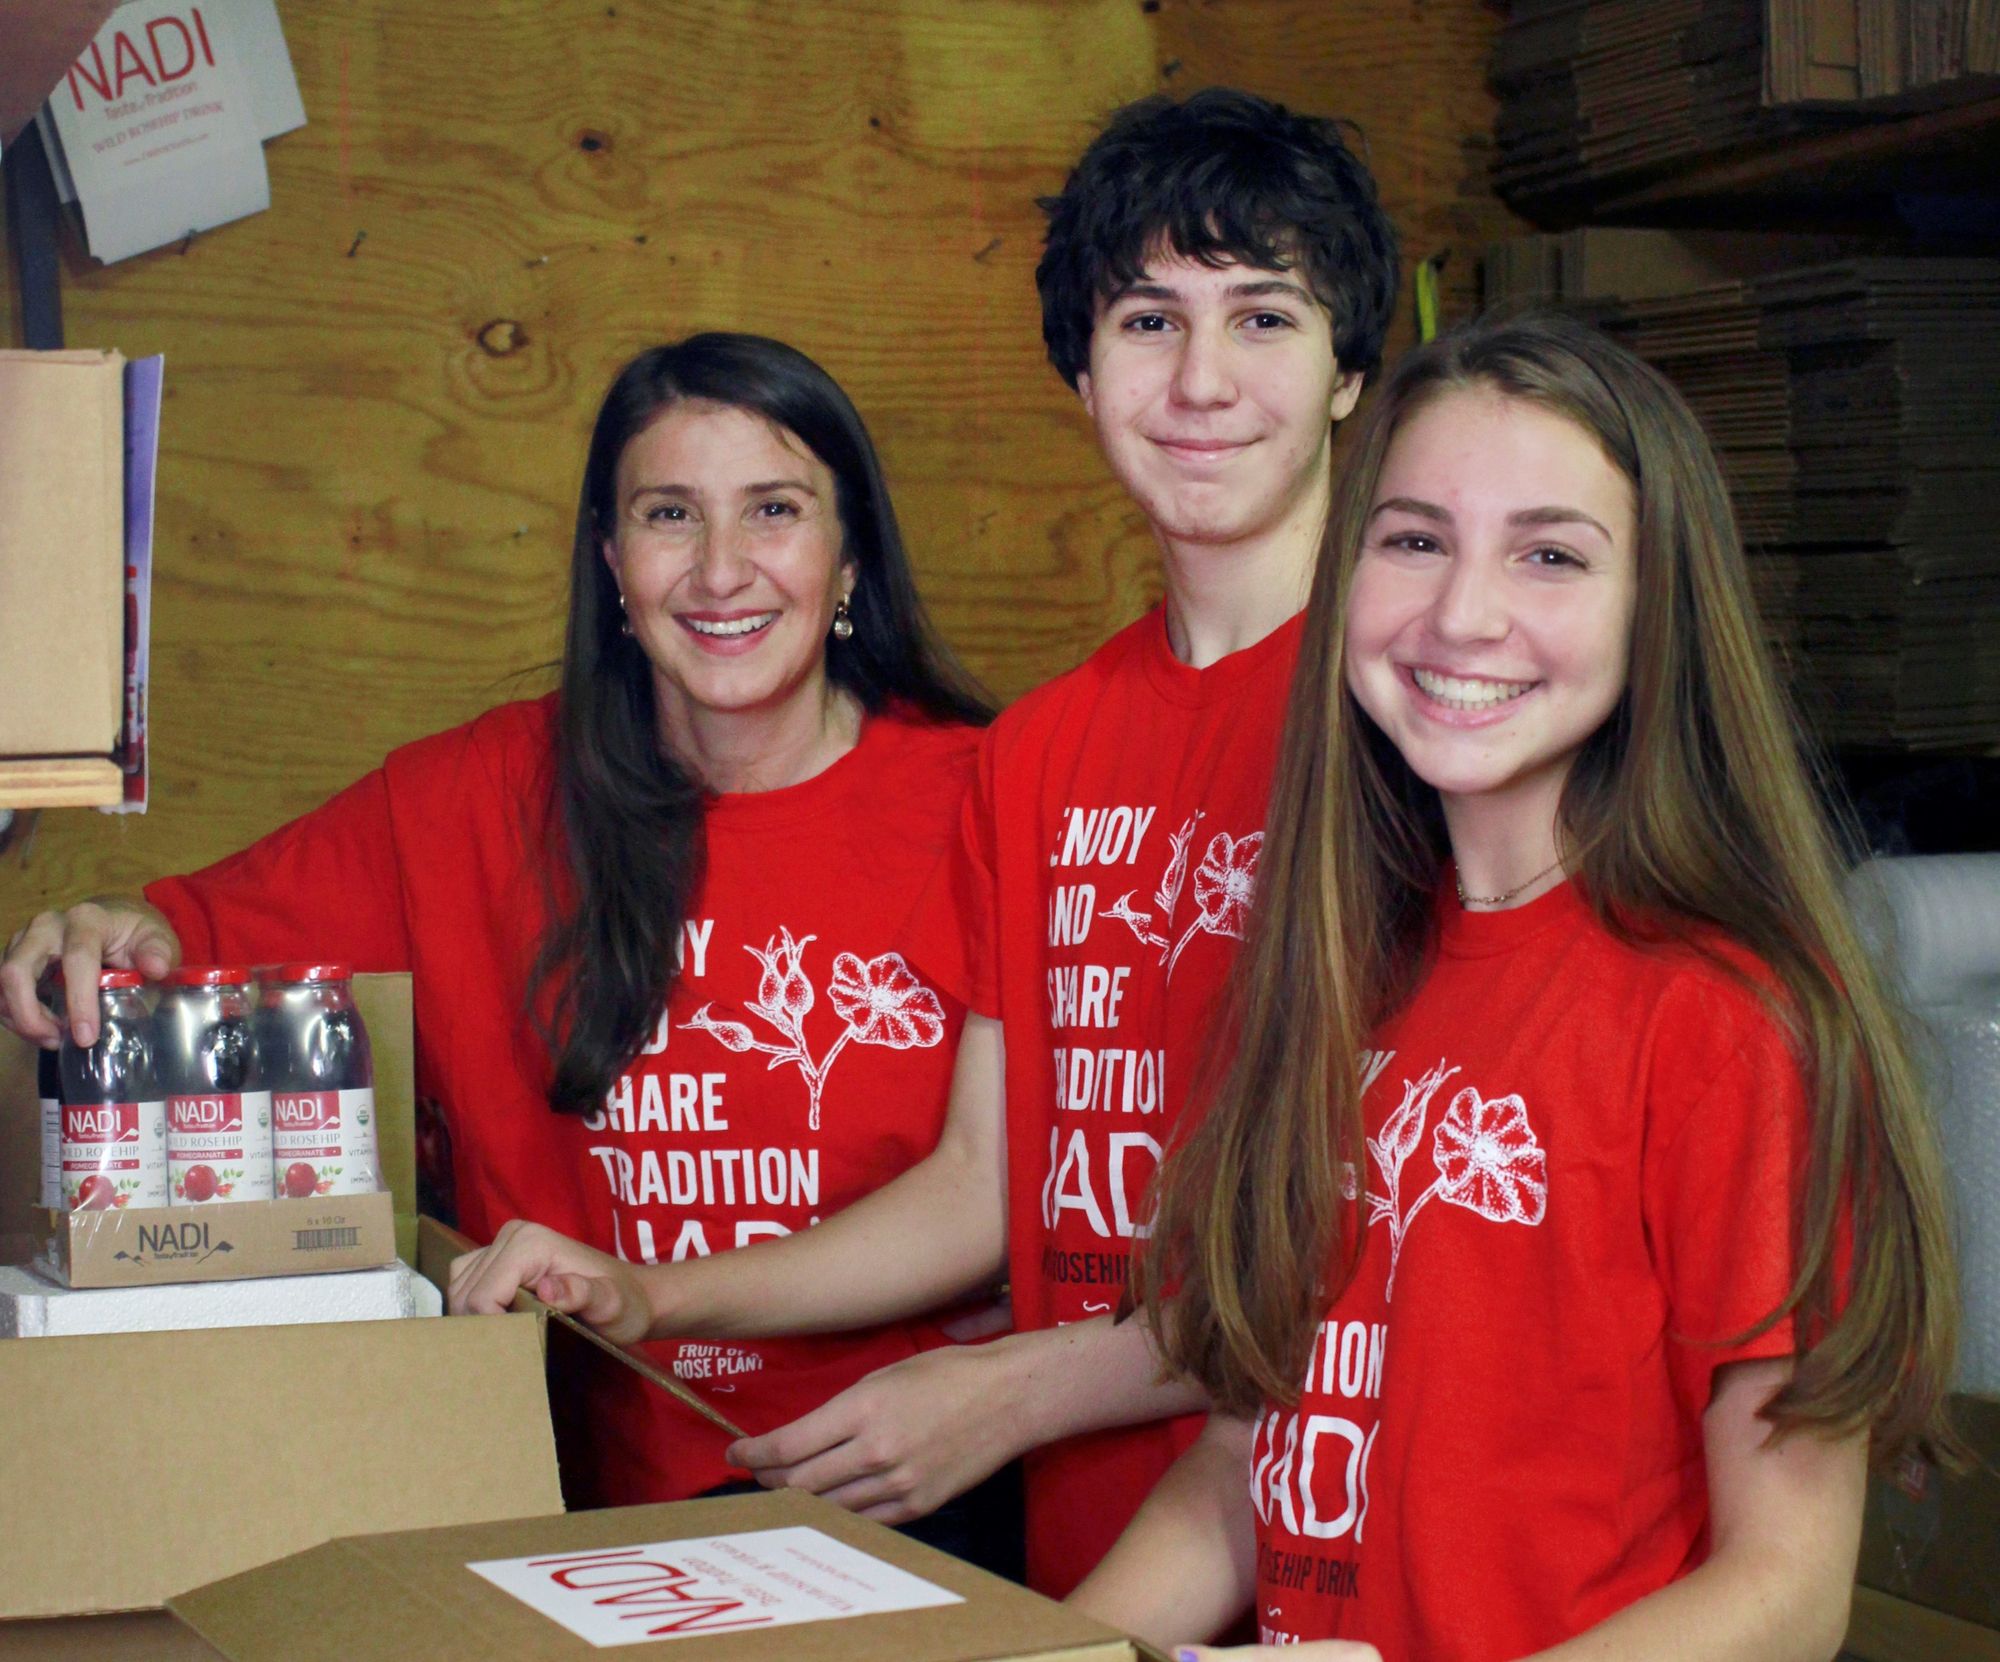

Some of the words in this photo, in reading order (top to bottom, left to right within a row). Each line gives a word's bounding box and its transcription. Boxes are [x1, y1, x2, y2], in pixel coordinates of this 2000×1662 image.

[66, 7, 216, 112] NADI
[1049, 883, 1096, 947] ND
[68, 1109, 121, 1133] NADI
[174, 1100, 225, 1123] NADI
[274, 1098, 323, 1121] NADI
[190, 1135, 242, 1148] ROSEHIP
[290, 1133, 341, 1146] ROSEHIP
[86, 1146, 139, 1158] ROEHIP
[176, 1151, 226, 1159] POMEGRANATE
[589, 1146, 819, 1206] TRADITION
[139, 1222, 209, 1253] NADI
[678, 1343, 723, 1358] FRUIT
[673, 1358, 712, 1379] ROSE
[528, 1550, 773, 1635] NADI
